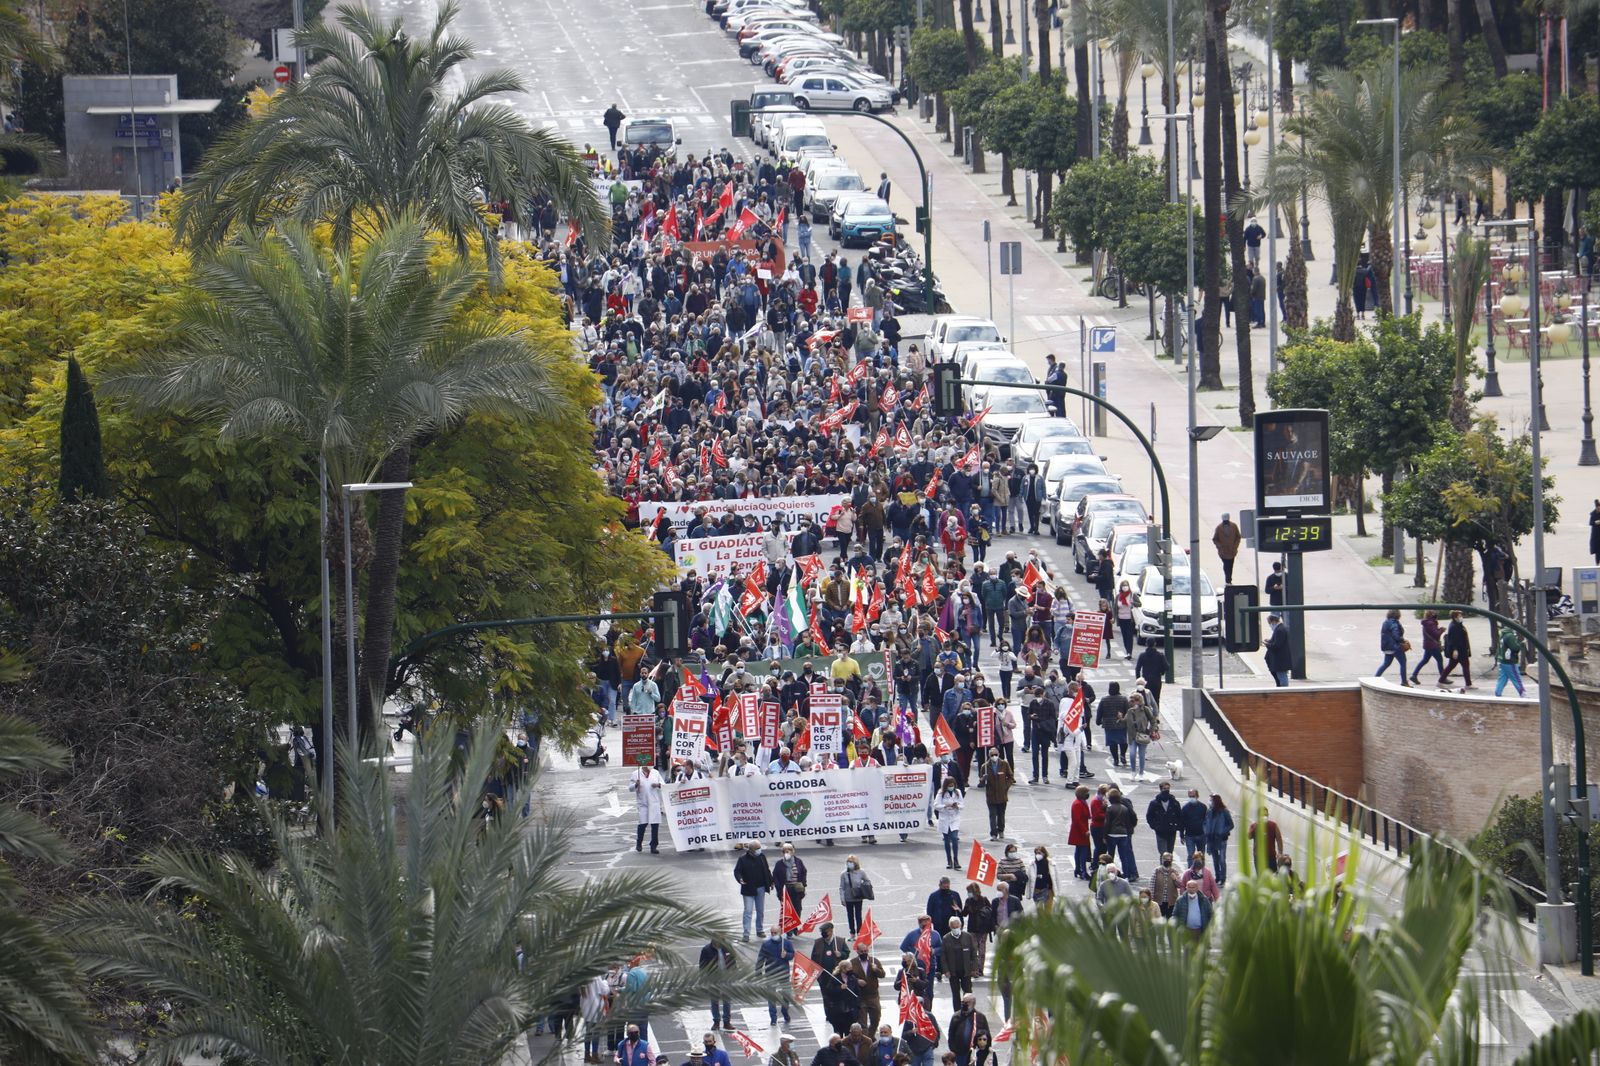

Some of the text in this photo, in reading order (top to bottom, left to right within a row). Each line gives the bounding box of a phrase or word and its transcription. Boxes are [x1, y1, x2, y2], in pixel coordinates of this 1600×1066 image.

[1267, 450, 1318, 460] SAUVAGE
[1274, 526, 1320, 540] 12:39
[680, 543, 695, 552] EL
[716, 551, 730, 560] La
[707, 563, 726, 572] Las
[744, 697, 757, 737] CCOO
[812, 713, 840, 726] NO
[675, 718, 705, 733] NO
[764, 705, 777, 747] CCOO
[982, 710, 991, 746] CCOO
[769, 779, 827, 791] CÓRDOBA
[824, 791, 869, 800] #RECUPEREMOS
[884, 792, 923, 801] #SANIDAD
[825, 803, 868, 812] PROFESIONALES
[884, 801, 917, 810] PÚBLICA
[677, 806, 714, 817] #SANIDAD
[677, 816, 708, 826] PÚBLICA
[688, 835, 708, 845] POR
[710, 834, 723, 842] EL
[725, 830, 766, 840] EMPLEO
[769, 830, 776, 838] Y
[780, 826, 837, 837] DERECHOS
[839, 825, 854, 833] EN
[857, 823, 870, 831] LA
[873, 820, 920, 831] SANIDAD
